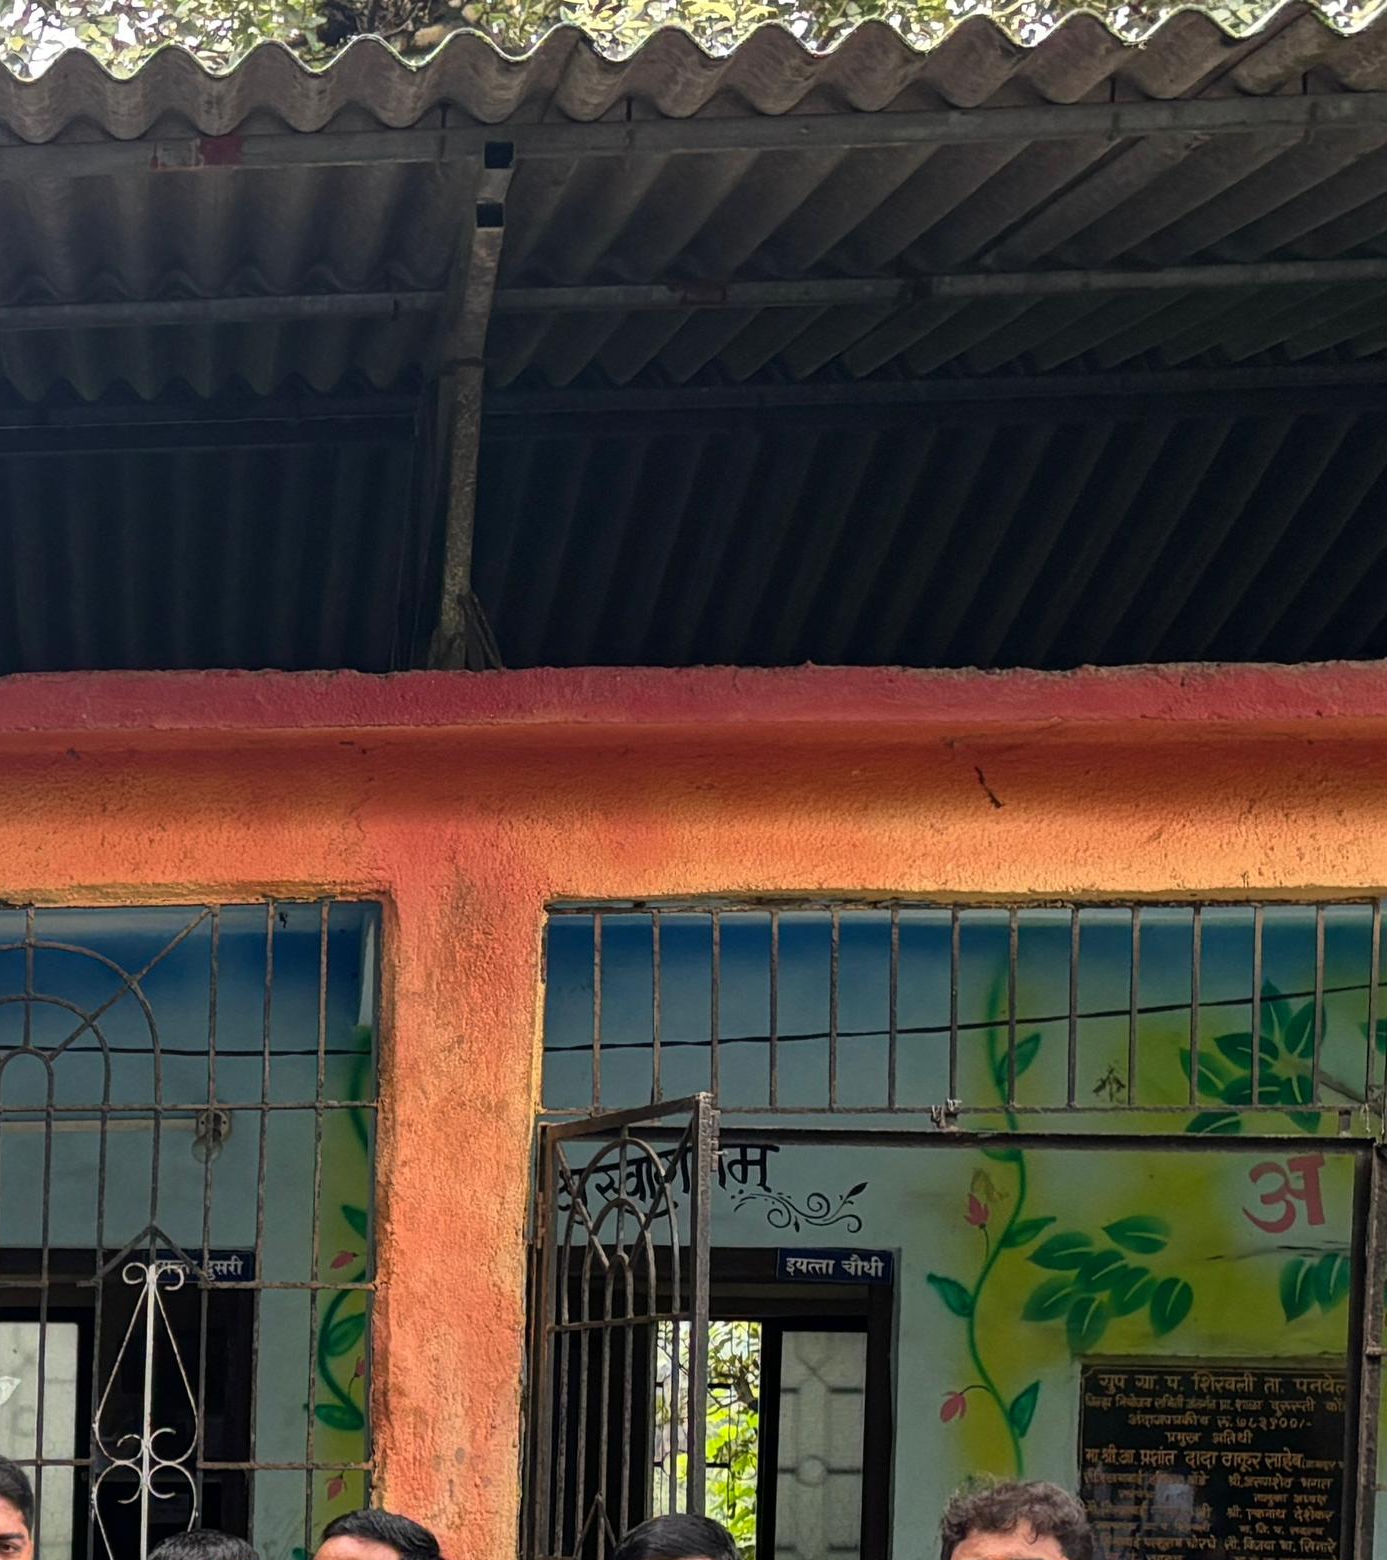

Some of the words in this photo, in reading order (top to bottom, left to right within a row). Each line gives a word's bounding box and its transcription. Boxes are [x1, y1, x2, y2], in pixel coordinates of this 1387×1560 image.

[1243, 1155, 1328, 1234] अ
[785, 1256, 835, 1276] इयत्ता
[841, 1253, 885, 1277] चौथी
